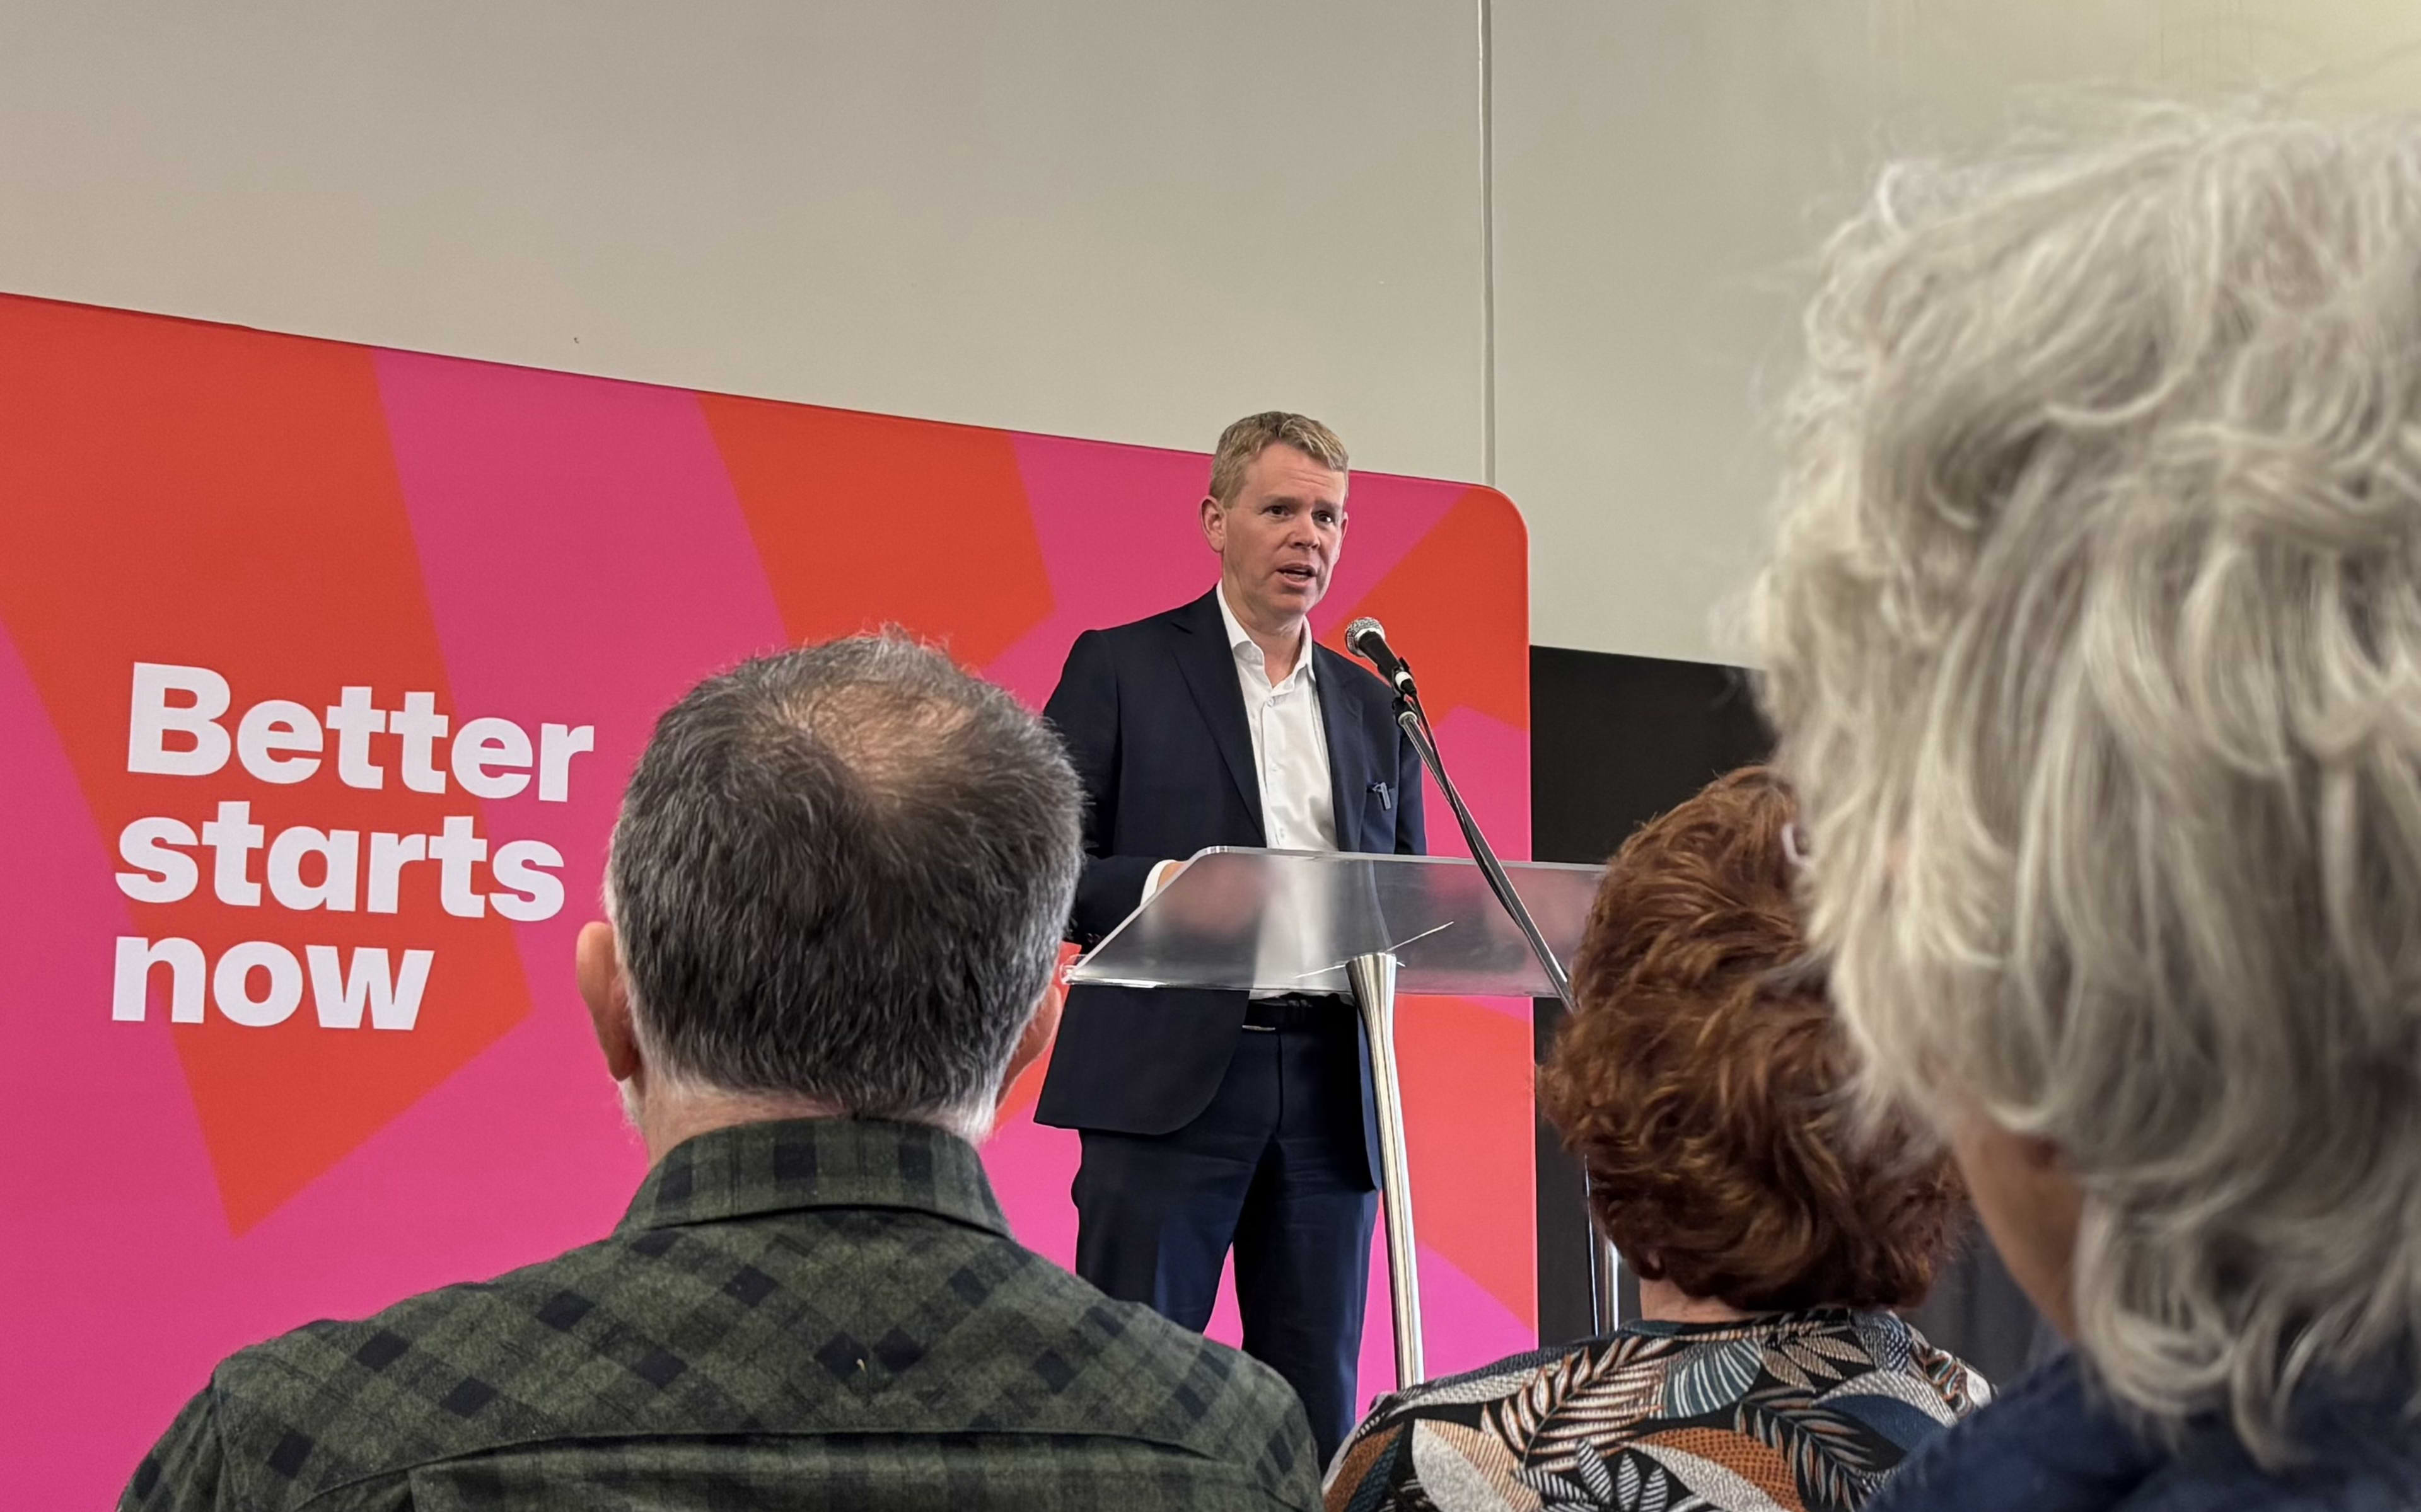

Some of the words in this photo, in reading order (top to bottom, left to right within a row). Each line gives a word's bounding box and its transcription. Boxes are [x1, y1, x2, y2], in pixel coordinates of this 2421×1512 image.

[127, 662, 595, 802] Better
[115, 800, 565, 921] starts
[112, 936, 434, 1030] now
